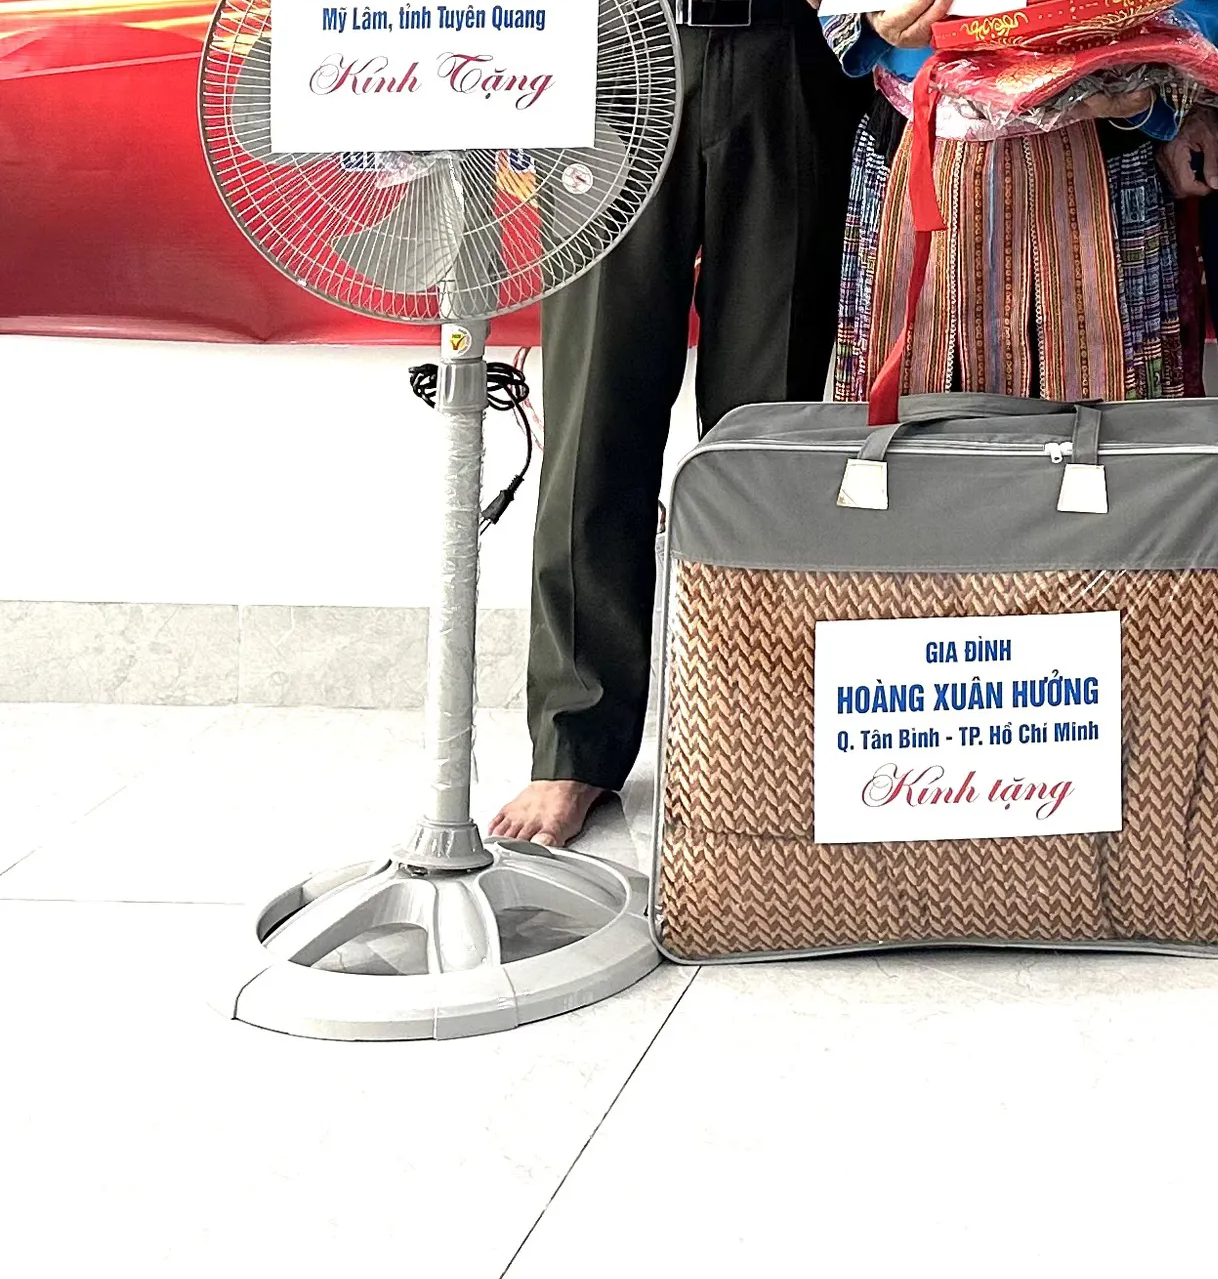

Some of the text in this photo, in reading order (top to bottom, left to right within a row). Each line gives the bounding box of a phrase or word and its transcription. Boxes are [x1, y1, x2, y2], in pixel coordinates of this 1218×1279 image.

[322, 2, 546, 33] Mỹ Lâm, tỉnh Tuyên Quang
[437, 51, 556, 111] Tặng
[925, 635, 1012, 664] GIA ĐÌNH
[837, 668, 1099, 714] HOÀNG XUÂN HƯỞNG
[837, 730, 855, 752] Q.
[860, 728, 893, 750] Tân
[959, 726, 984, 747] TP.
[989, 721, 1013, 745] Hồ
[1018, 722, 1048, 745] Chí
[1053, 720, 1100, 742] Minh
[987, 776, 1076, 821] tặng
